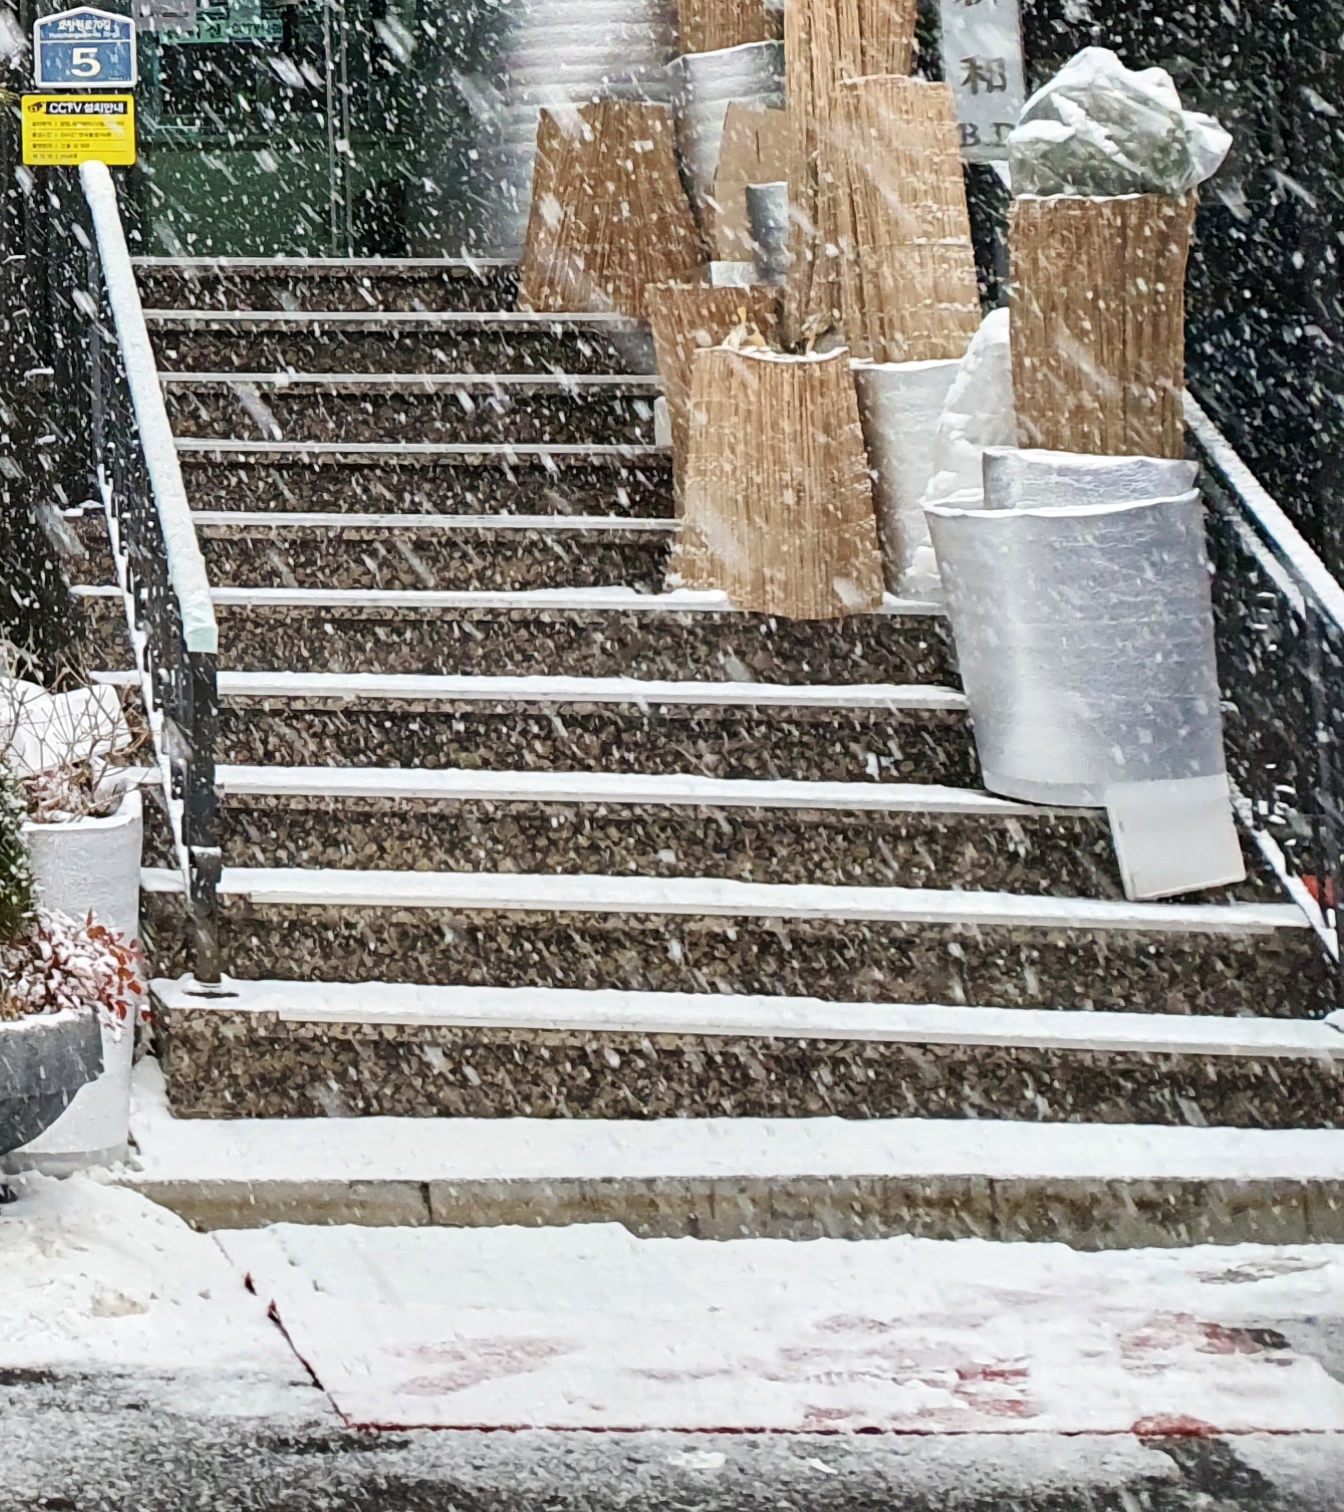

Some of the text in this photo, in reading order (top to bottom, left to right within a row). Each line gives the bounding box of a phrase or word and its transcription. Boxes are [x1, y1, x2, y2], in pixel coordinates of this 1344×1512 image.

[70, 47, 102, 78] 5
[49, 102, 124, 114] CCTV 설치안내
